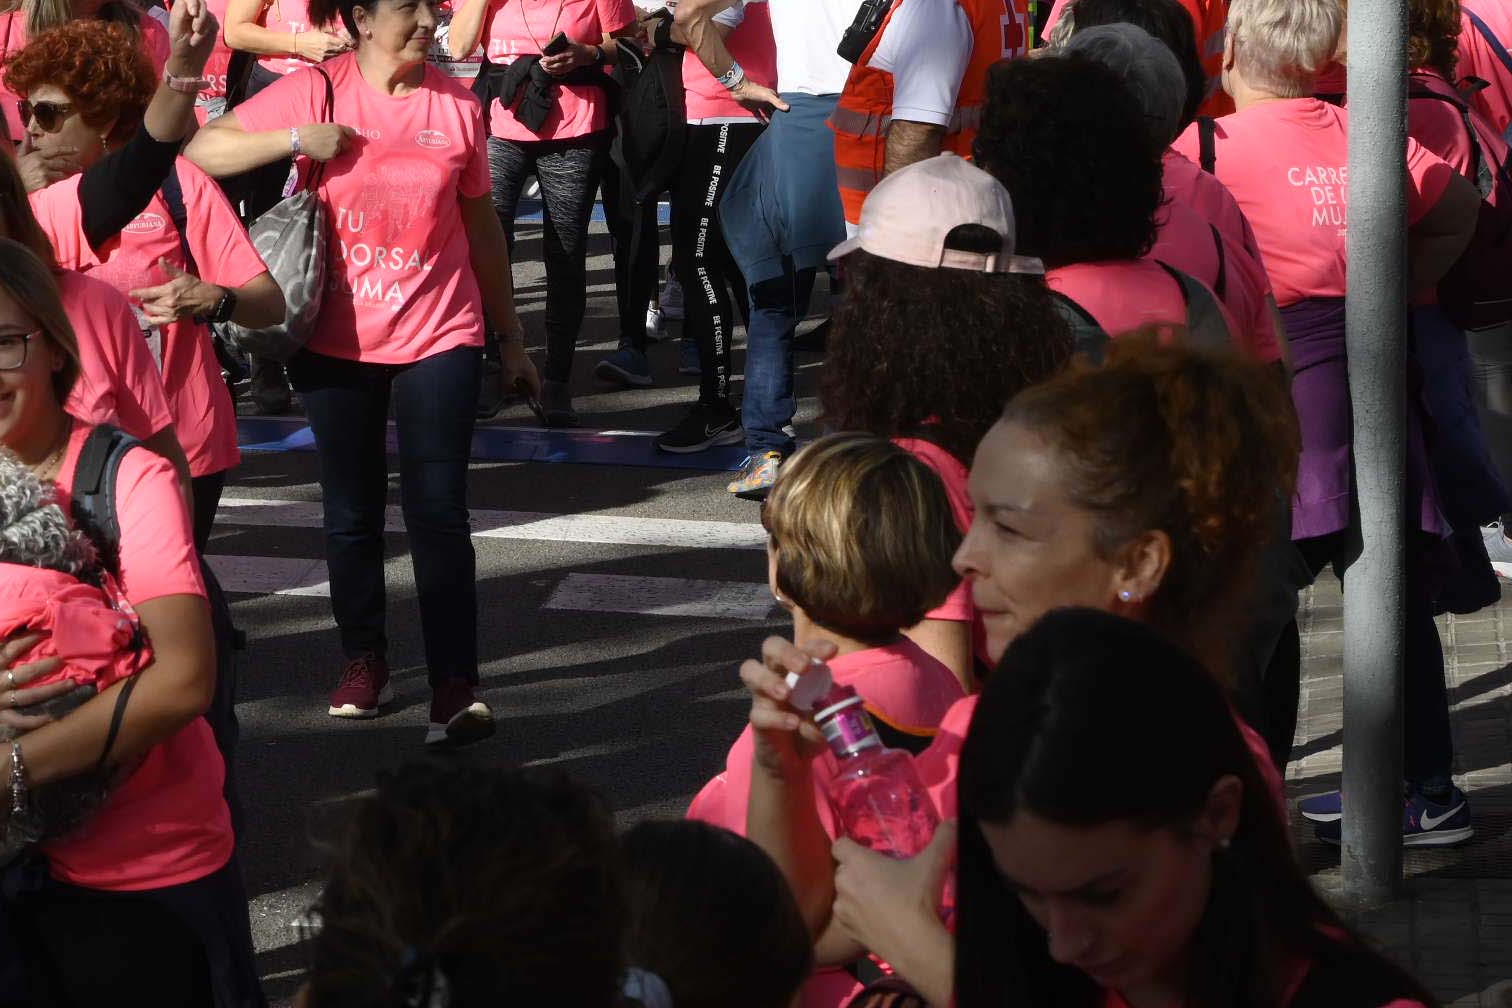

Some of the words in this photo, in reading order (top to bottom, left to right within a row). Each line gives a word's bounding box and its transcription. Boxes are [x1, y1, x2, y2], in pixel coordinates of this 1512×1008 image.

[354, 127, 381, 140] SHO
[713, 165, 722, 176] BE
[1287, 165, 1348, 187] CARRE
[704, 177, 720, 207] POSITIVE
[1311, 185, 1337, 205] DE
[336, 207, 365, 233] TU
[701, 217, 709, 228] BE
[695, 230, 707, 258] POSITIVE
[353, 276, 405, 303] UMA
